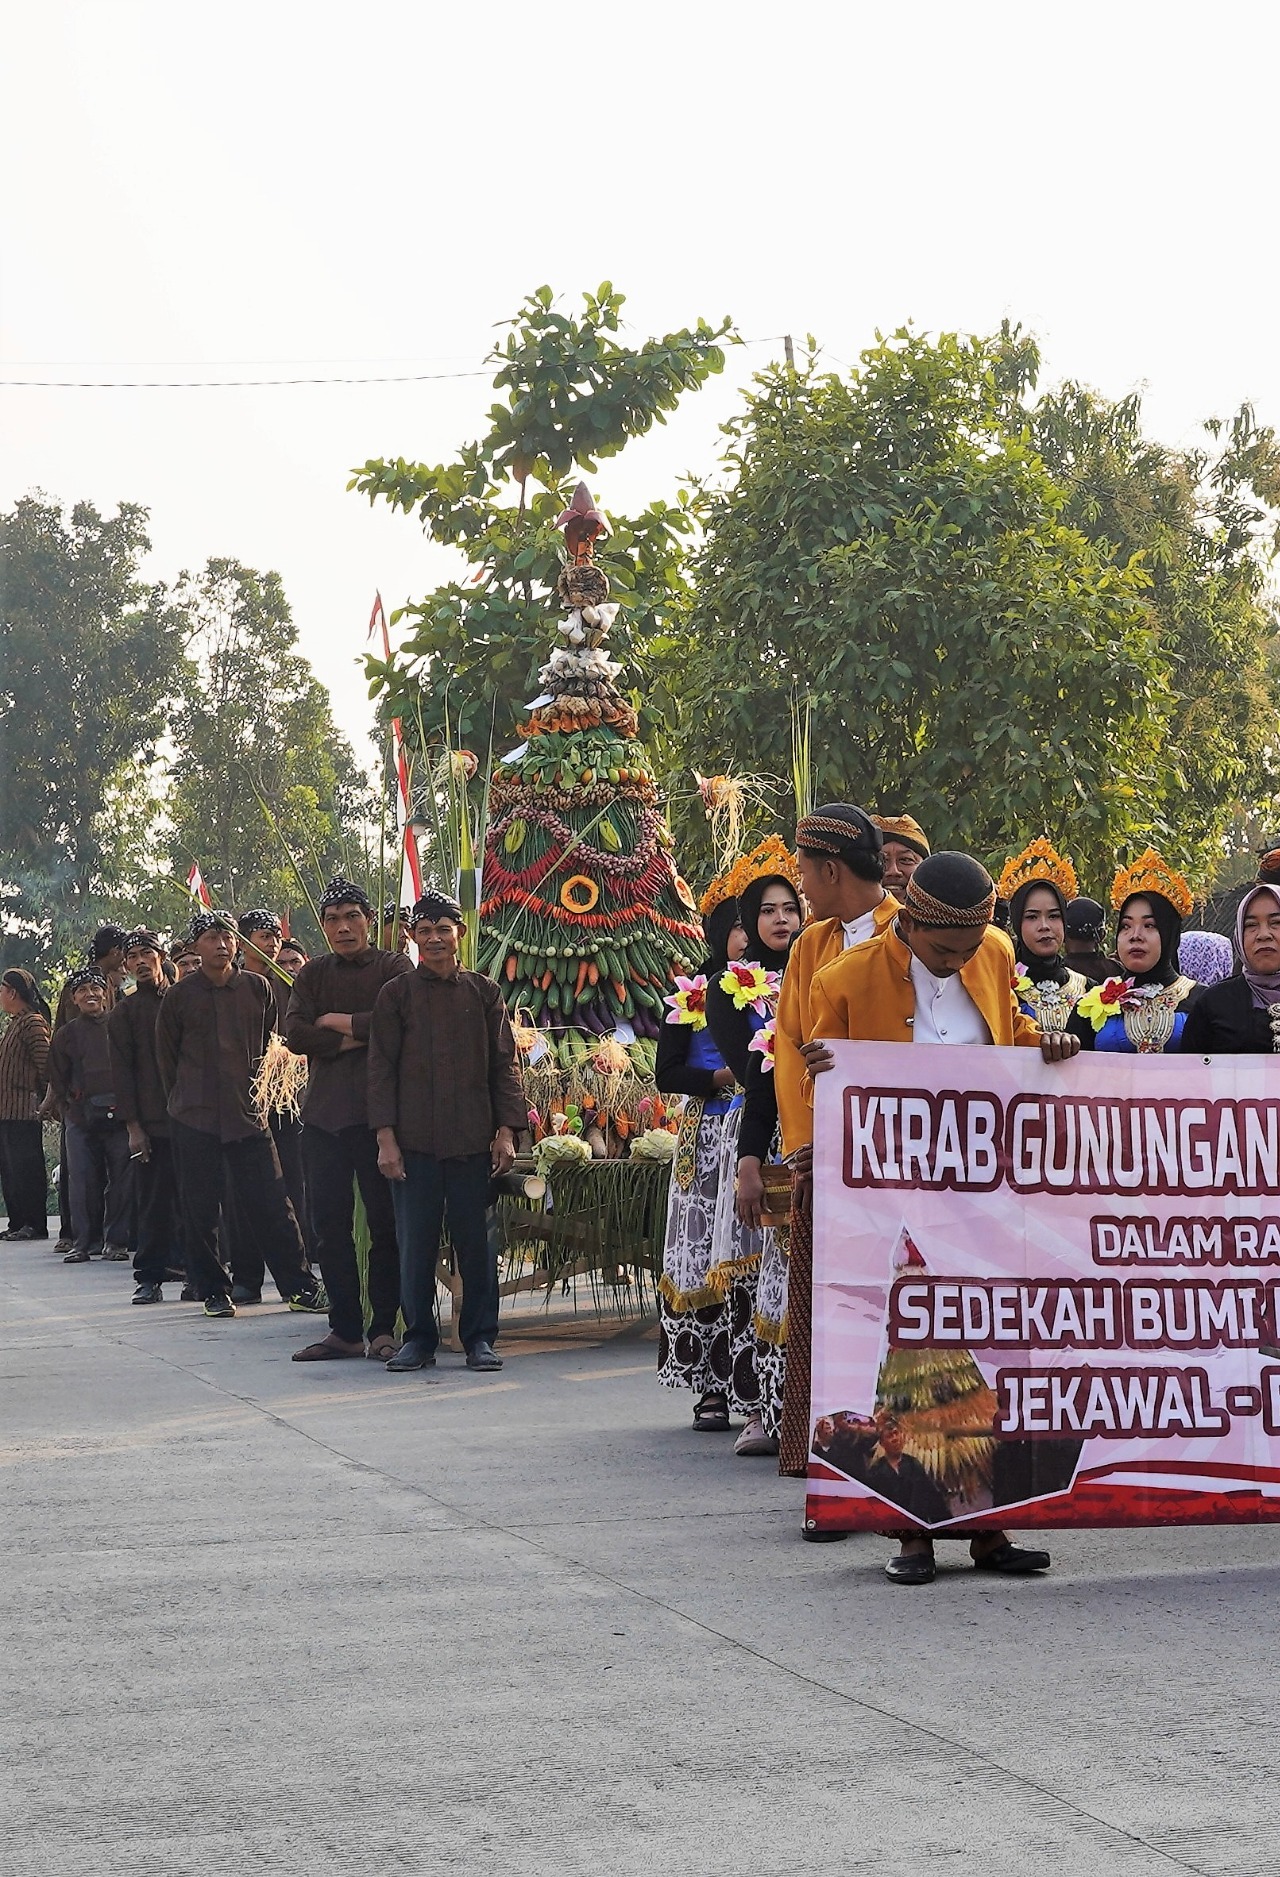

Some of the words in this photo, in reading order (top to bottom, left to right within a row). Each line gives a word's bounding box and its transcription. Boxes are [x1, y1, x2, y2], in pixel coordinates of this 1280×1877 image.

[850, 1096, 997, 1182] KIRAB
[1013, 1101, 1277, 1189] GUNUNGAN
[1097, 1223, 1222, 1259] DALAM
[898, 1287, 1116, 1341] SEDEKAH
[1132, 1287, 1259, 1340] BUMI
[1001, 1377, 1222, 1433] JEKAWAL
